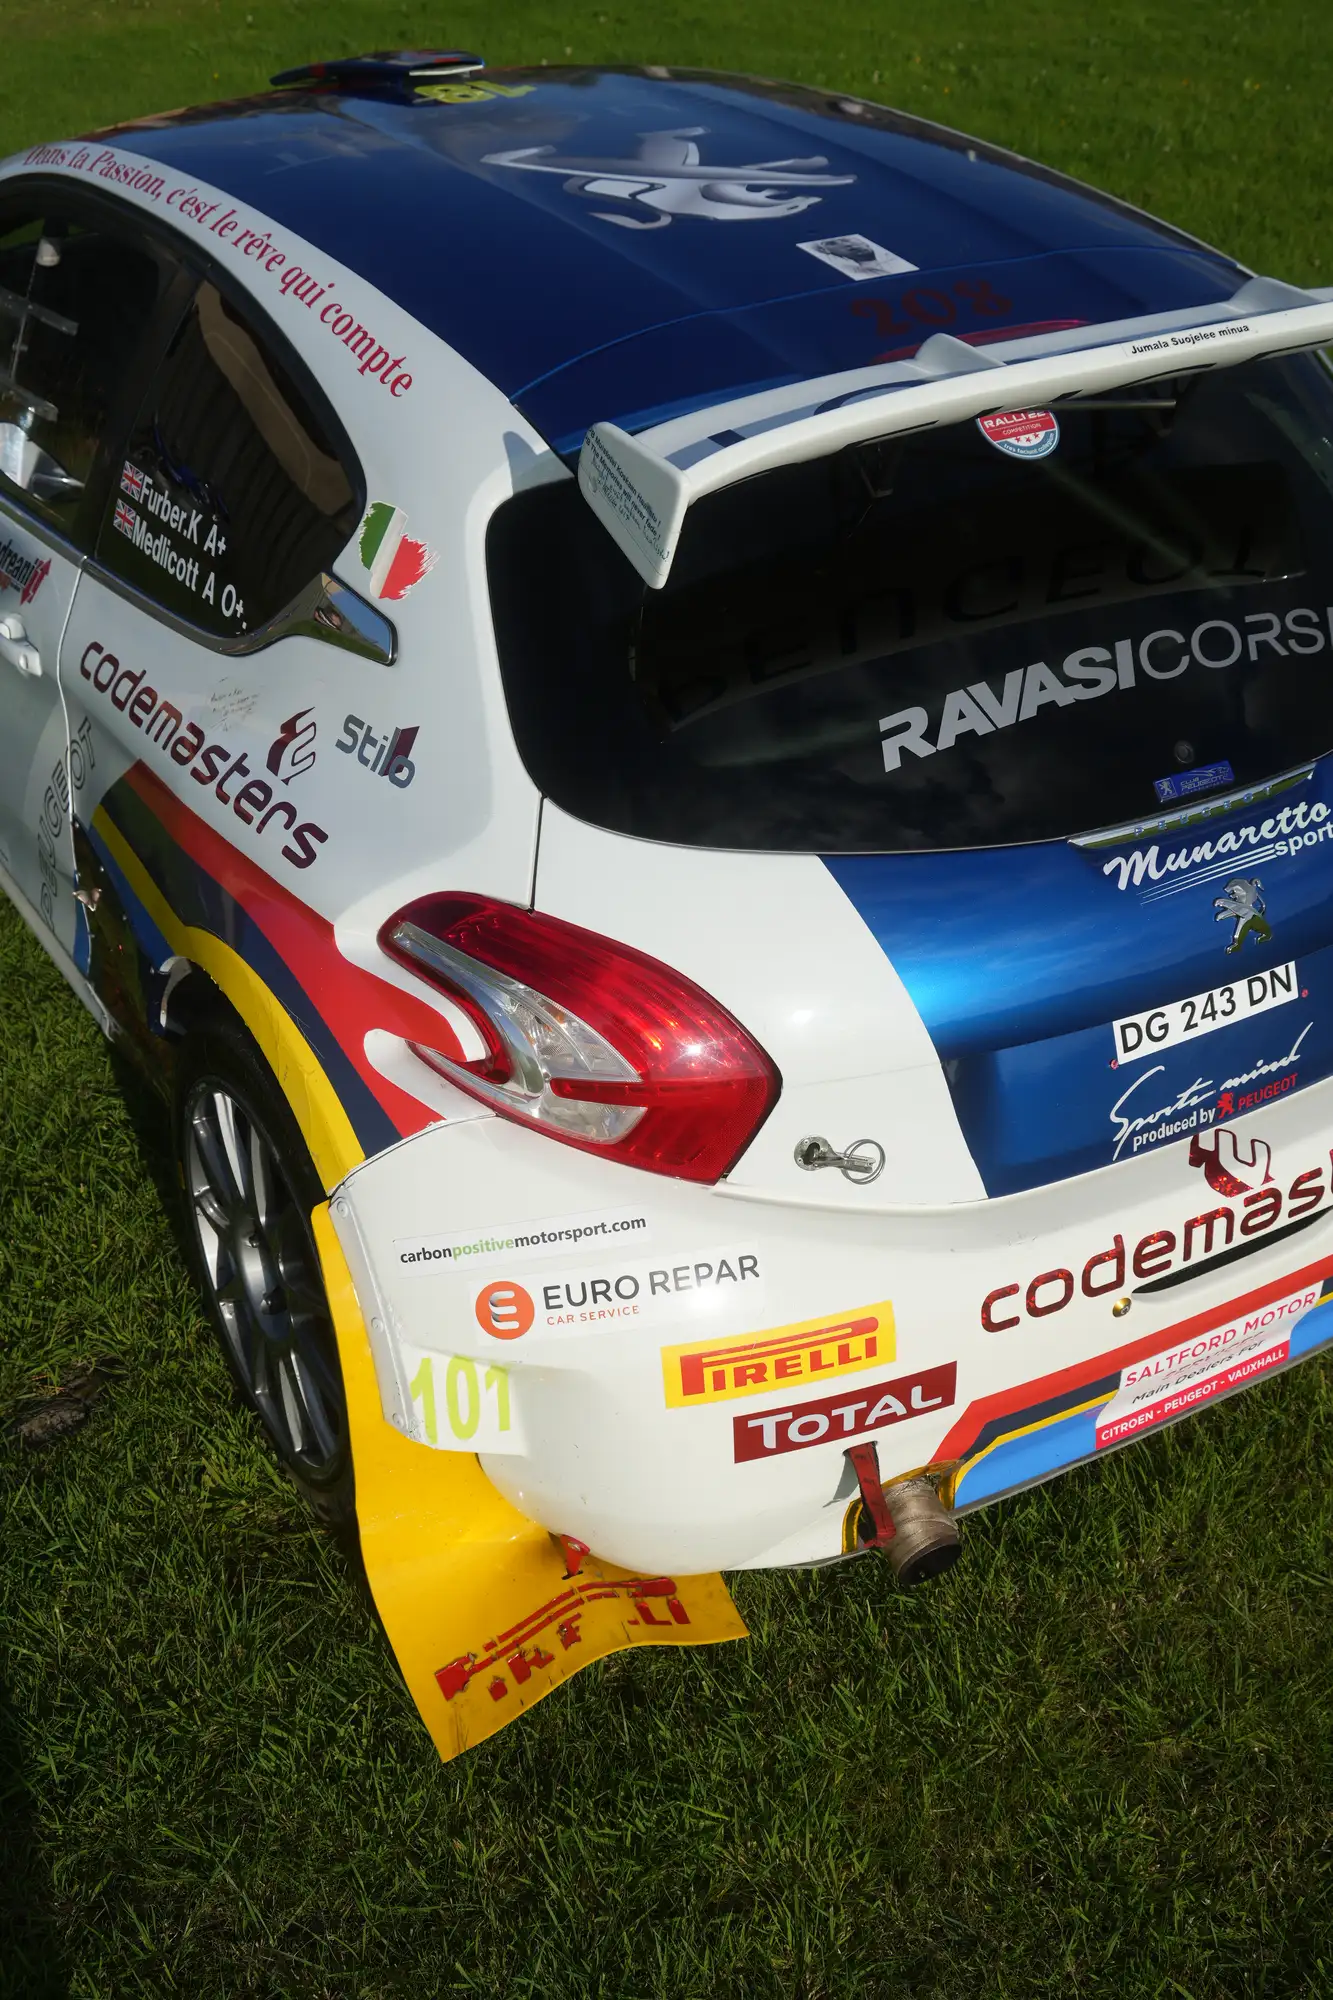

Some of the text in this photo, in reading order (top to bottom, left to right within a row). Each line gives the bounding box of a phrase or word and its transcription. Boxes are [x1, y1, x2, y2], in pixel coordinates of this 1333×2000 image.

[23, 145, 414, 399] Dans la Passion, c'est le rêve qui compte
[851, 278, 1014, 338] 208
[1131, 323, 1251, 355] Jumala Suojelee minua
[983, 412, 1027, 430] RALLI
[1002, 423, 1043, 437] COMPETITION
[138, 475, 228, 558] Furber.K A+
[131, 515, 245, 619] Medlicott A O+
[878, 606, 1333, 773] RAVASICORS
[79, 639, 330, 869] codemasters
[335, 713, 421, 790] Stilo
[1102, 800, 1332, 891] Munaretto
[1273, 820, 1333, 857] sport
[1119, 964, 1293, 1054] DG 243 DN
[1133, 1072, 1300, 1153] produced by PEUGEOT
[400, 1216, 648, 1265] carbonpositivemotorsport.com
[981, 1148, 1333, 1334] codemas
[542, 1253, 760, 1312] EURO REPAR
[546, 1304, 641, 1327] CAR SERVICE
[679, 1315, 880, 1397] PIRELLI
[1123, 1327, 1239, 1390] SALTFORD
[1242, 1290, 1318, 1335] MOTOR
[408, 1353, 516, 1447] 101
[747, 1384, 943, 1451] TOTAL
[1101, 1410, 1155, 1443] CITROEN
[1163, 1379, 1218, 1414] PEUGEOT
[1226, 1347, 1286, 1384] VAUXHALL
[1132, 1380, 1173, 1406] Main
